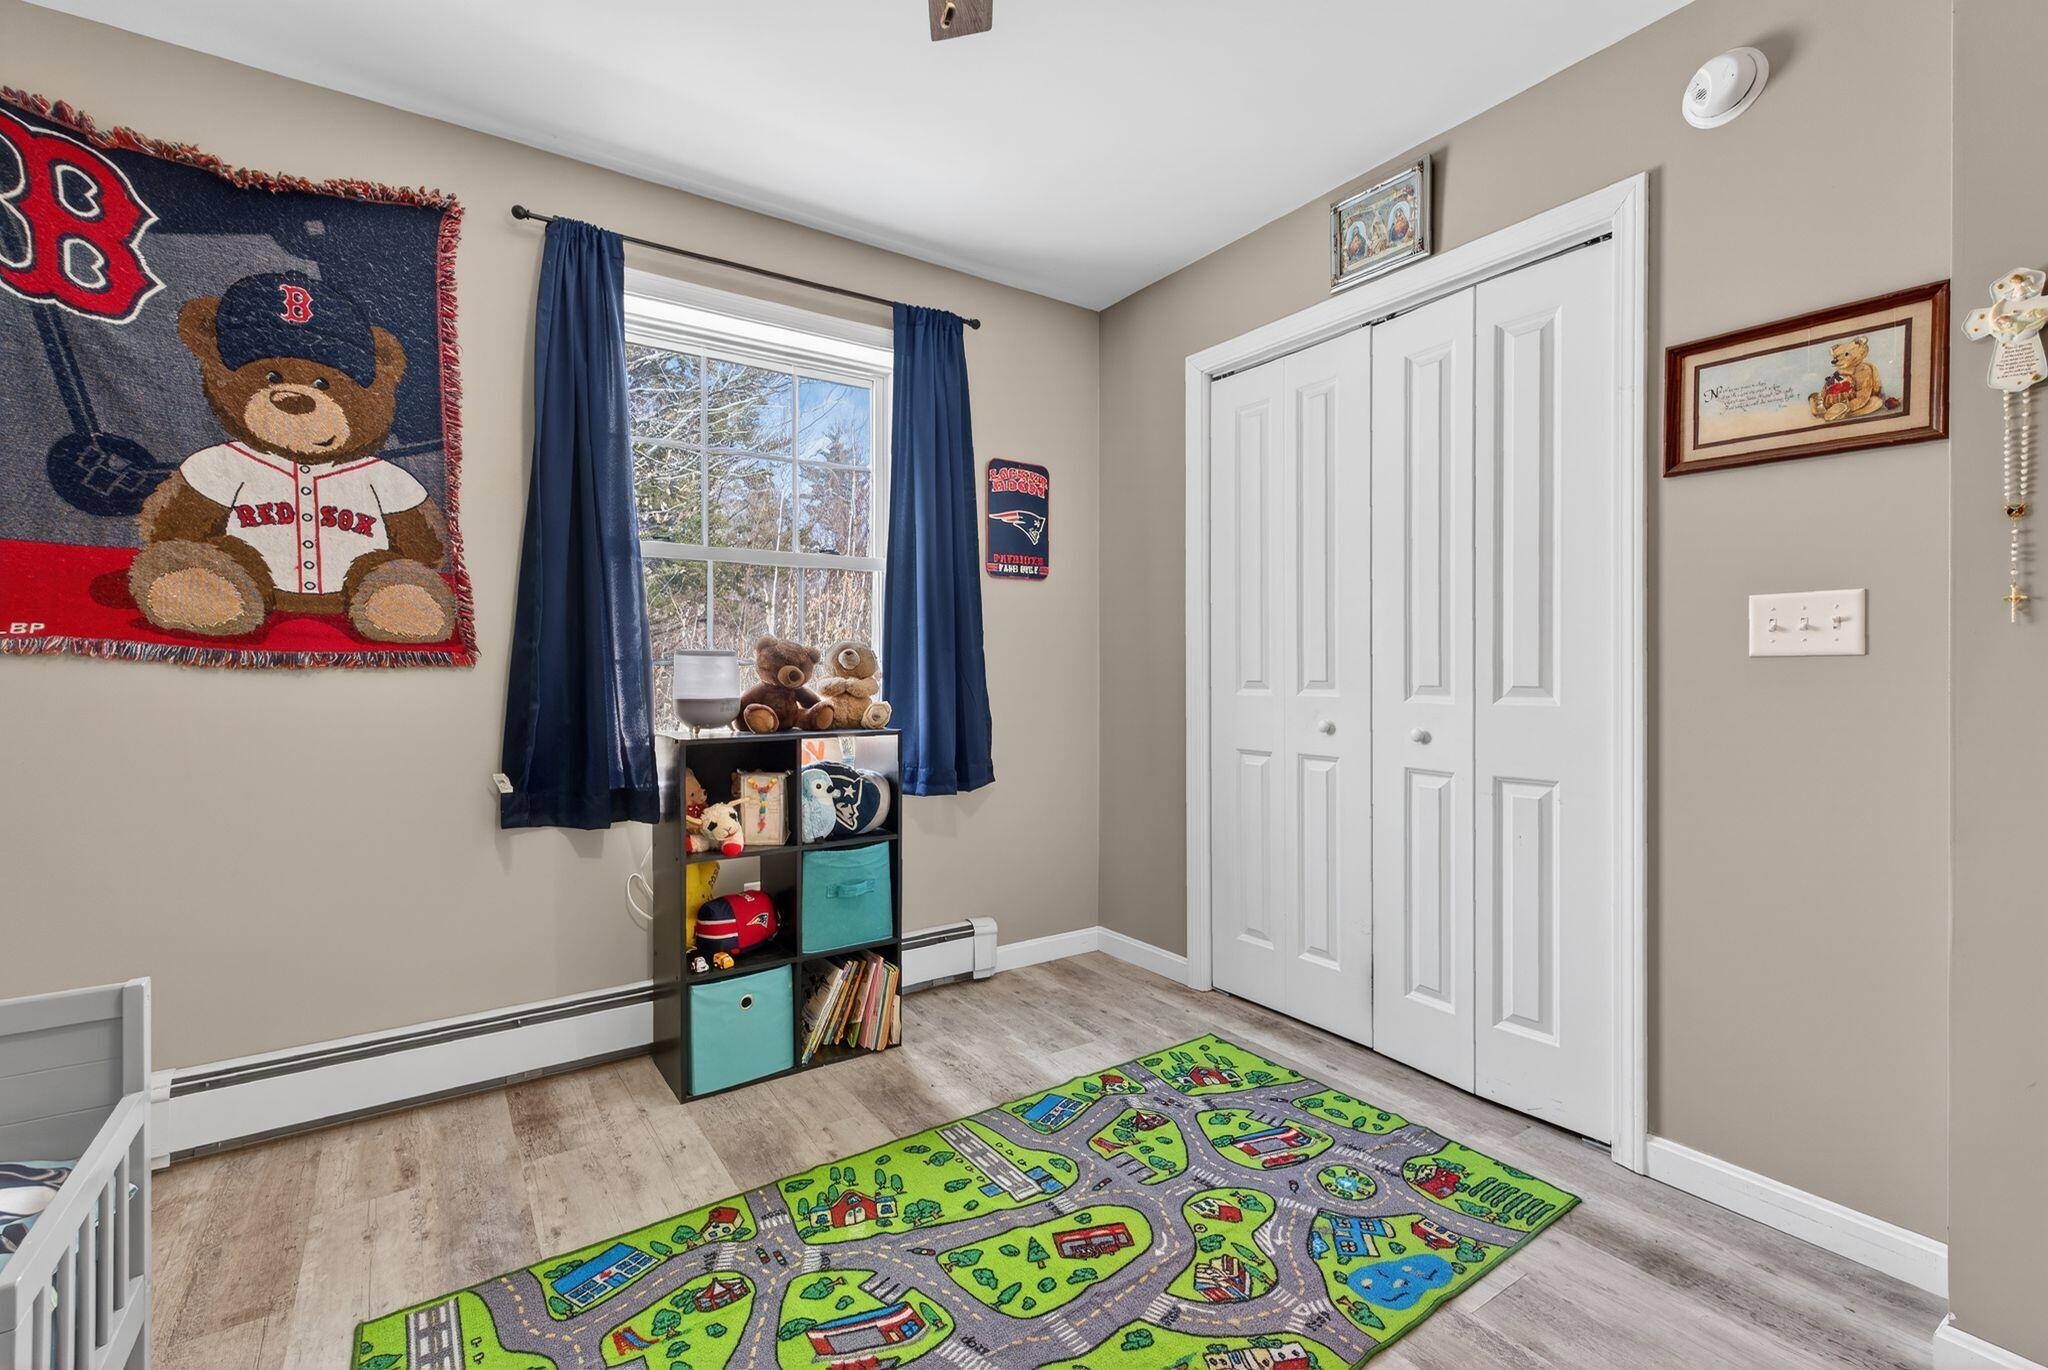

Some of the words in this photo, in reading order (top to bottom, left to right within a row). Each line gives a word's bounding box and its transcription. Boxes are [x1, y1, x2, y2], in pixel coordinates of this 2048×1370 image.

[0, 107, 167, 324] B
[279, 284, 314, 323] B
[234, 502, 295, 528] RED
[320, 505, 377, 538] SOX
